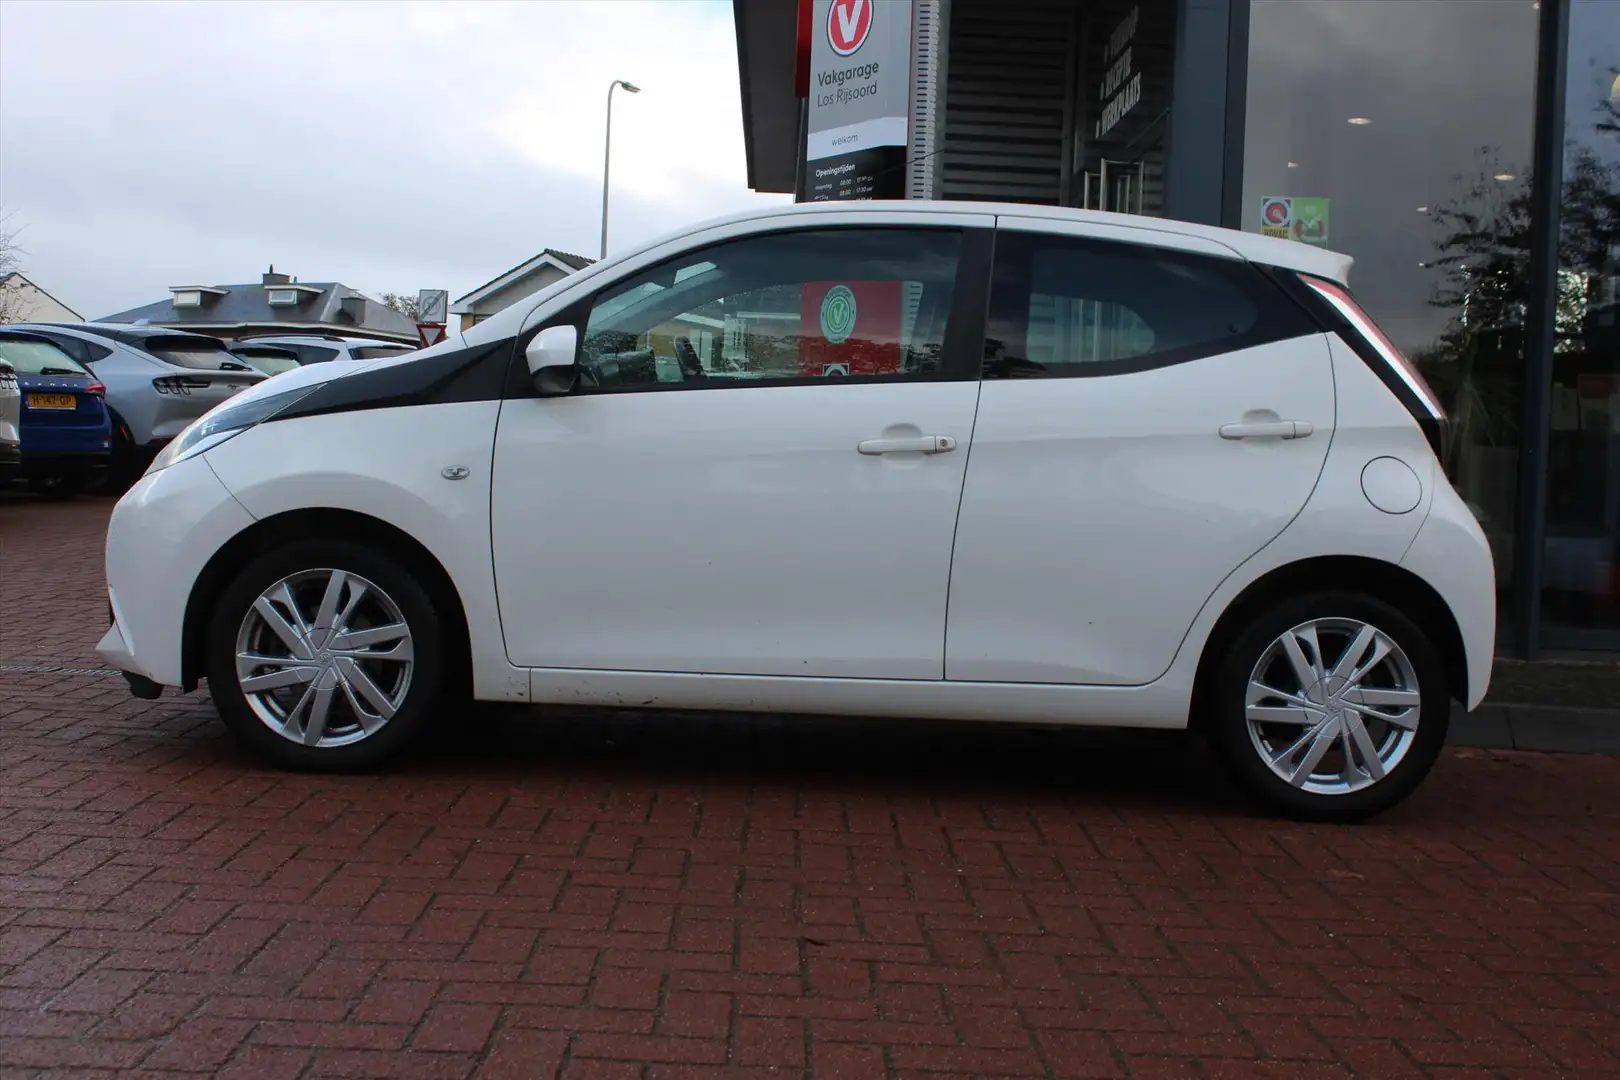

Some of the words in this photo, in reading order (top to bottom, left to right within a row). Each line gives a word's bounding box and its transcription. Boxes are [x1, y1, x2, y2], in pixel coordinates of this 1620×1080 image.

[818, 62, 879, 87] Vakgarage
[817, 94, 834, 108] Los
[836, 81, 878, 105] Rijsoord
[831, 133, 859, 147] welkom
[815, 164, 856, 179] Openingstijden
